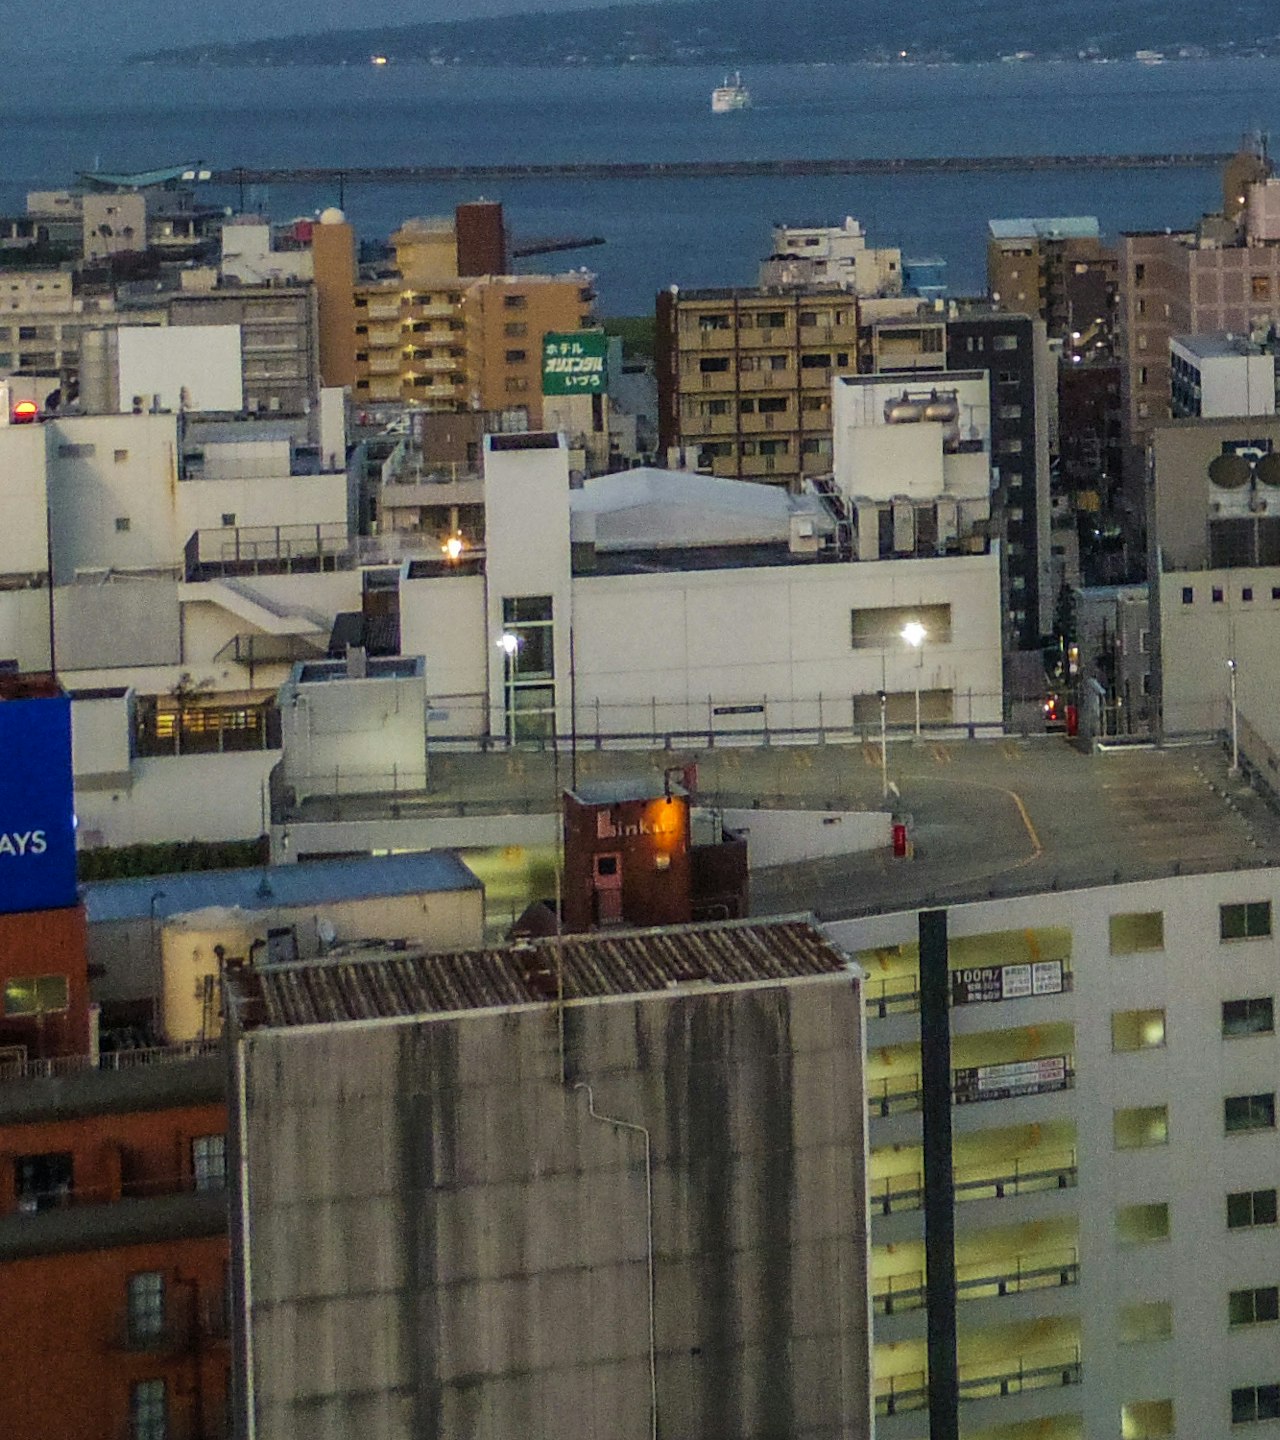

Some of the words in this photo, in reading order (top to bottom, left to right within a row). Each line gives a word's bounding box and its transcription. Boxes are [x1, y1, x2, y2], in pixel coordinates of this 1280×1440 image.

[546, 343, 583, 355] ホテル
[565, 374, 600, 386] いづろ
